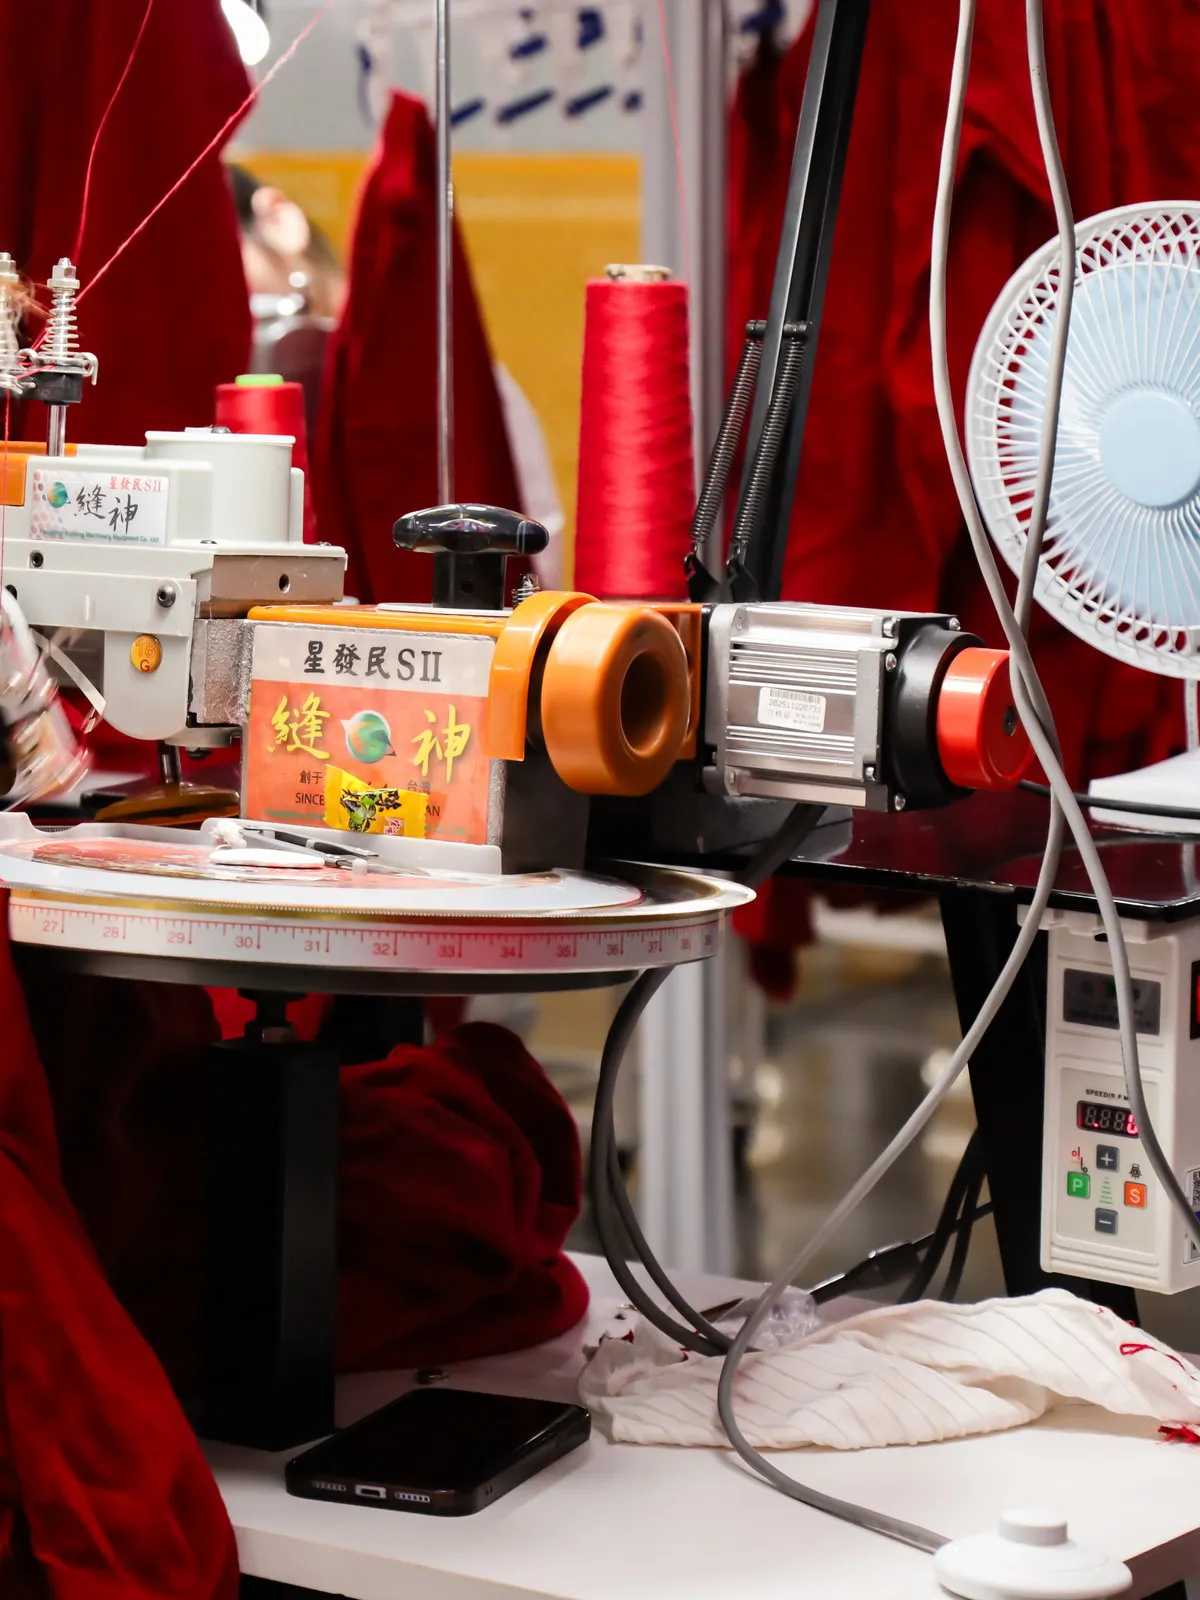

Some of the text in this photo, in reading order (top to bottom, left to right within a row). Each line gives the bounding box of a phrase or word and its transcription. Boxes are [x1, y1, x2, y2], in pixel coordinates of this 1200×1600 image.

[140, 659, 150, 672] G
[295, 792, 325, 806] SINCE
[42, 920, 58, 933] 27
[102, 926, 119, 939] 28
[167, 932, 185, 944] 29
[235, 936, 253, 949] 30
[304, 940, 321, 952] 31
[372, 943, 390, 956] 32
[439, 945, 456, 958] 33
[500, 945, 516, 958] 34
[556, 945, 571, 958] 35
[606, 943, 620, 956] 36
[1072, 1178, 1083, 1193] P
[1130, 1188, 1141, 1204] S
